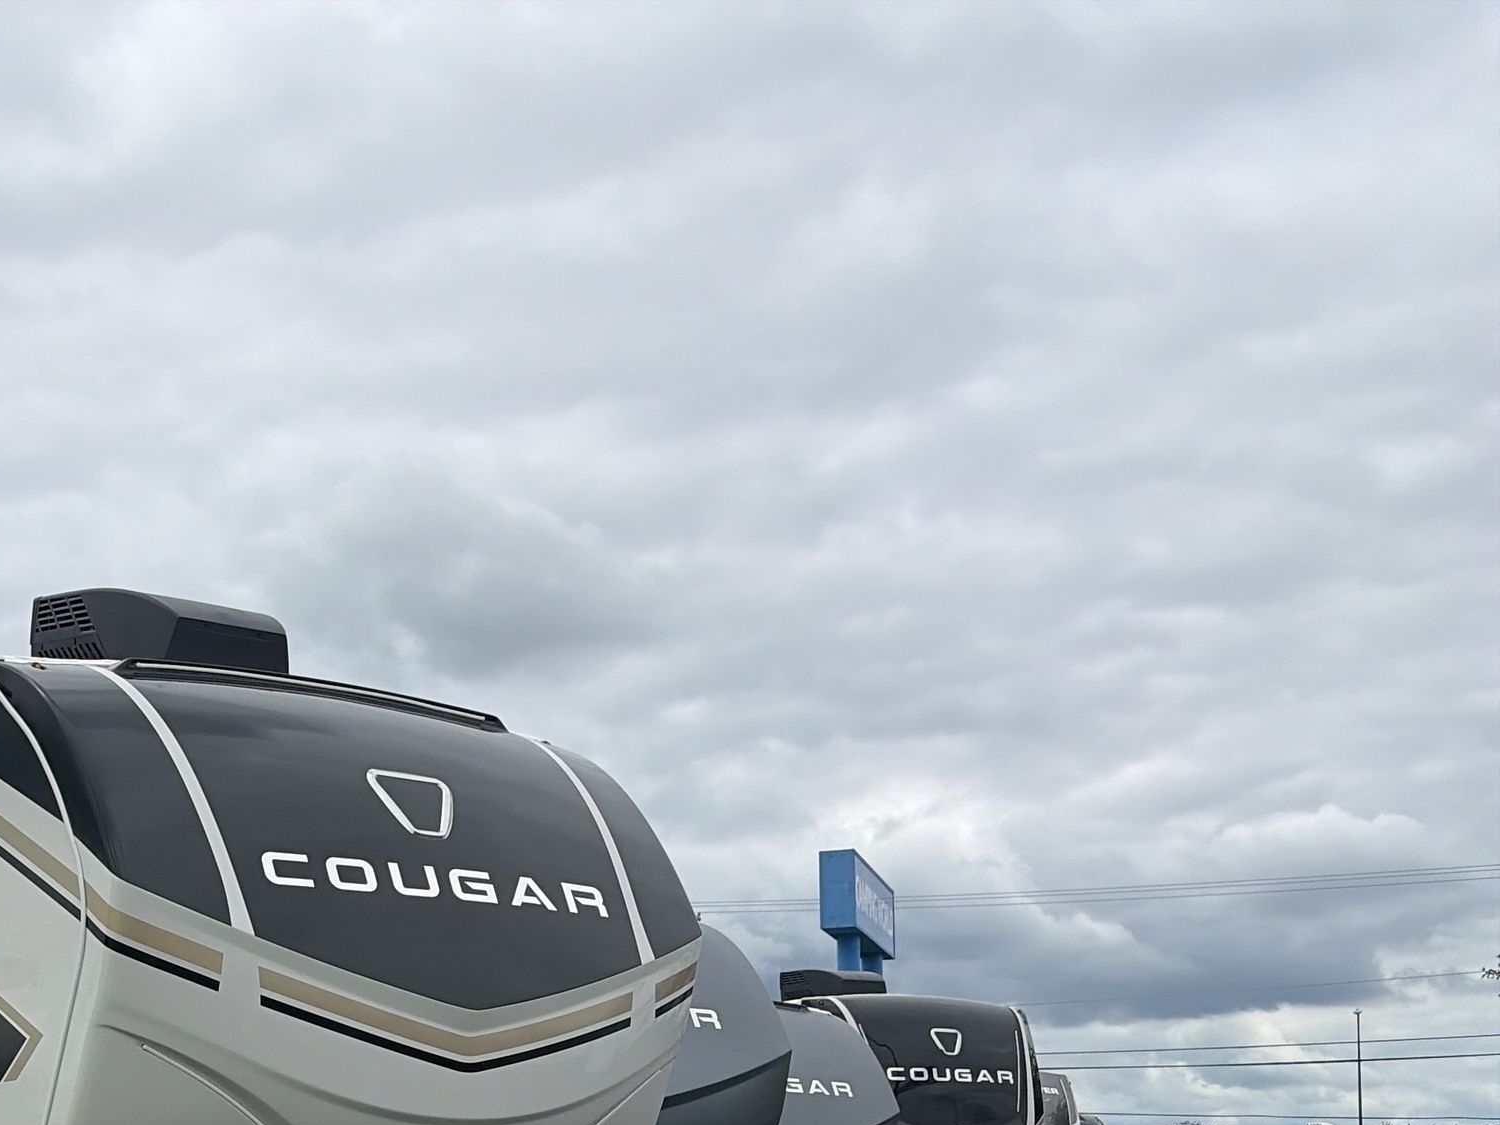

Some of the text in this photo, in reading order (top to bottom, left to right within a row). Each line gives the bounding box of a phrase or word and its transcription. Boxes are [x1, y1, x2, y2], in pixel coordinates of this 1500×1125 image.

[261, 851, 609, 918] COUGAR
[886, 1066, 1014, 1085] COUGAR
[786, 1077, 853, 1098] GAR
